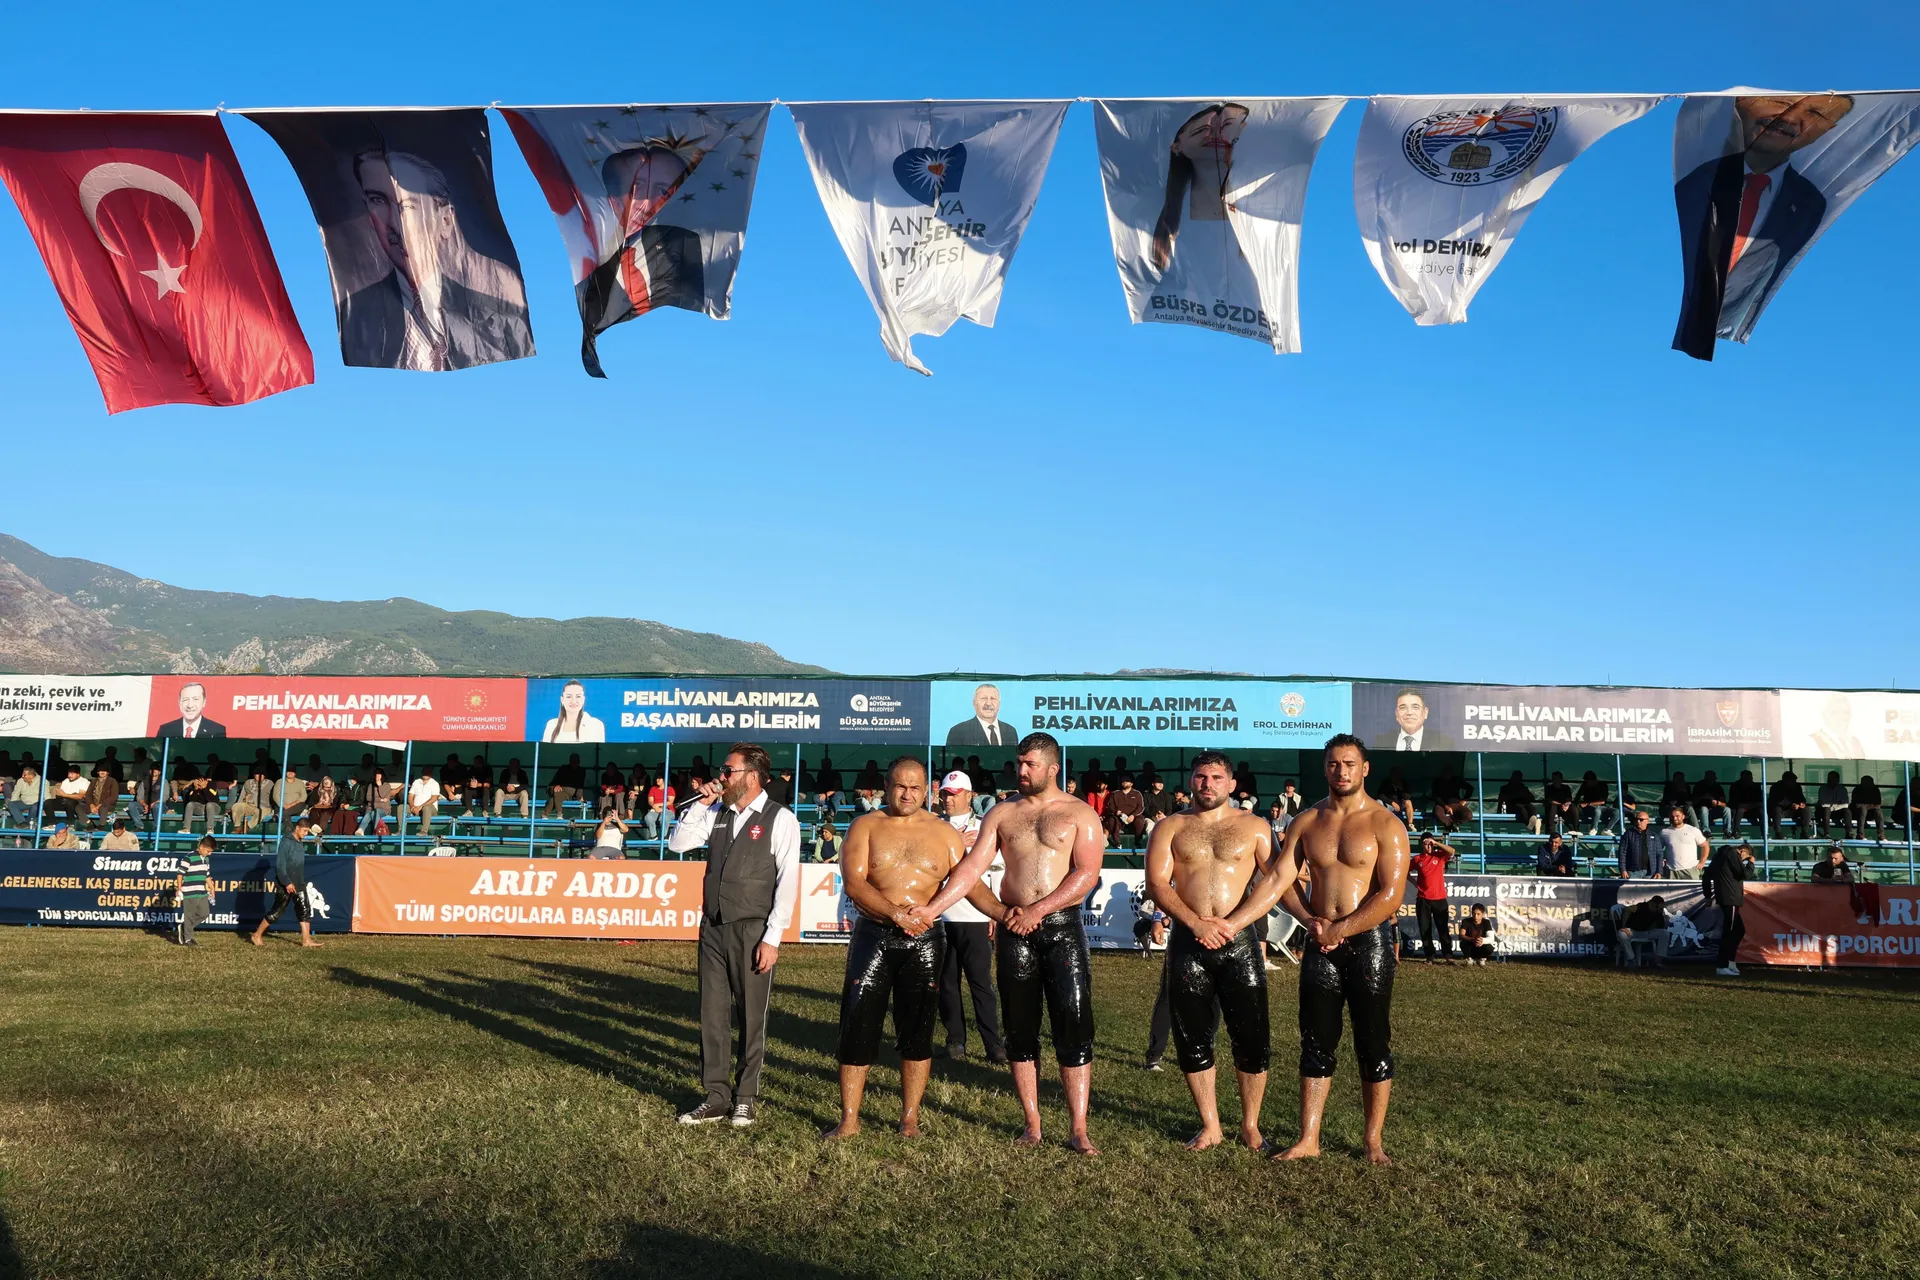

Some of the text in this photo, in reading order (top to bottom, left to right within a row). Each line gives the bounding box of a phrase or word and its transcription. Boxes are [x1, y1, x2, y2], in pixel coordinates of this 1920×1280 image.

[1450, 172, 1480, 183] 1923
[1394, 239, 1417, 254] rol
[1404, 261, 1455, 277] elediye
[1151, 294, 1274, 332] Büşra ÖZDE
[1154, 313, 1273, 342] Antalya Büyükşehir Belediye Baş
[13, 685, 46, 699] zeki,
[49, 686, 85, 699] çevik
[90, 688, 105, 698] ve
[232, 690, 433, 711] PEHLİVANLARIMIZA
[623, 687, 819, 708] PEHLİVANLARIMIZA
[0, 699, 52, 711] laklısını
[1034, 693, 1237, 712] PEHLİVANLARIMIZA
[271, 713, 389, 732] BAŞARILAR
[442, 715, 507, 723] TÜRKİYE CUMHURİYETİ
[621, 710, 821, 731] BAŞARILAR DİLERİM
[839, 716, 911, 727] BÜŞRA ÖZDEMİR
[1032, 713, 1239, 732] BAŞARILAR DİLERİM
[1465, 702, 1672, 724] PEHLİVANLARIMIZA
[1885, 709, 1920, 724] PE
[441, 723, 507, 731] CUMHURBAŞKANLIĞI
[1253, 720, 1332, 729] EROL DEMİRHAN
[1463, 724, 1674, 743] BAŞARILAR DİLERİM
[1687, 726, 1771, 739] İBRAHİM TÜRKİŞ
[93, 856, 180, 876] Sinan ÇEL
[86, 877, 111, 893] KAŞ
[113, 876, 181, 891] BELEDİYES
[230, 878, 277, 893] PEHLİV
[470, 863, 678, 906] ARİF ARDIÇ
[1496, 880, 1558, 902] ÇELİK
[97, 892, 182, 910] GÜREŞ AĞASI
[38, 907, 62, 920] TÜM
[64, 909, 134, 922] SPORCULARA
[136, 911, 184, 926] BAŞARILA
[395, 899, 702, 930] TÜM SPORCULARA BAŞARILAR Dİ
[1545, 904, 1588, 920] YAĞLI
[1494, 941, 1556, 956] BAŞARILAR
[1558, 940, 1605, 955] DİLERİZ
[1773, 928, 1820, 953] TÜM
